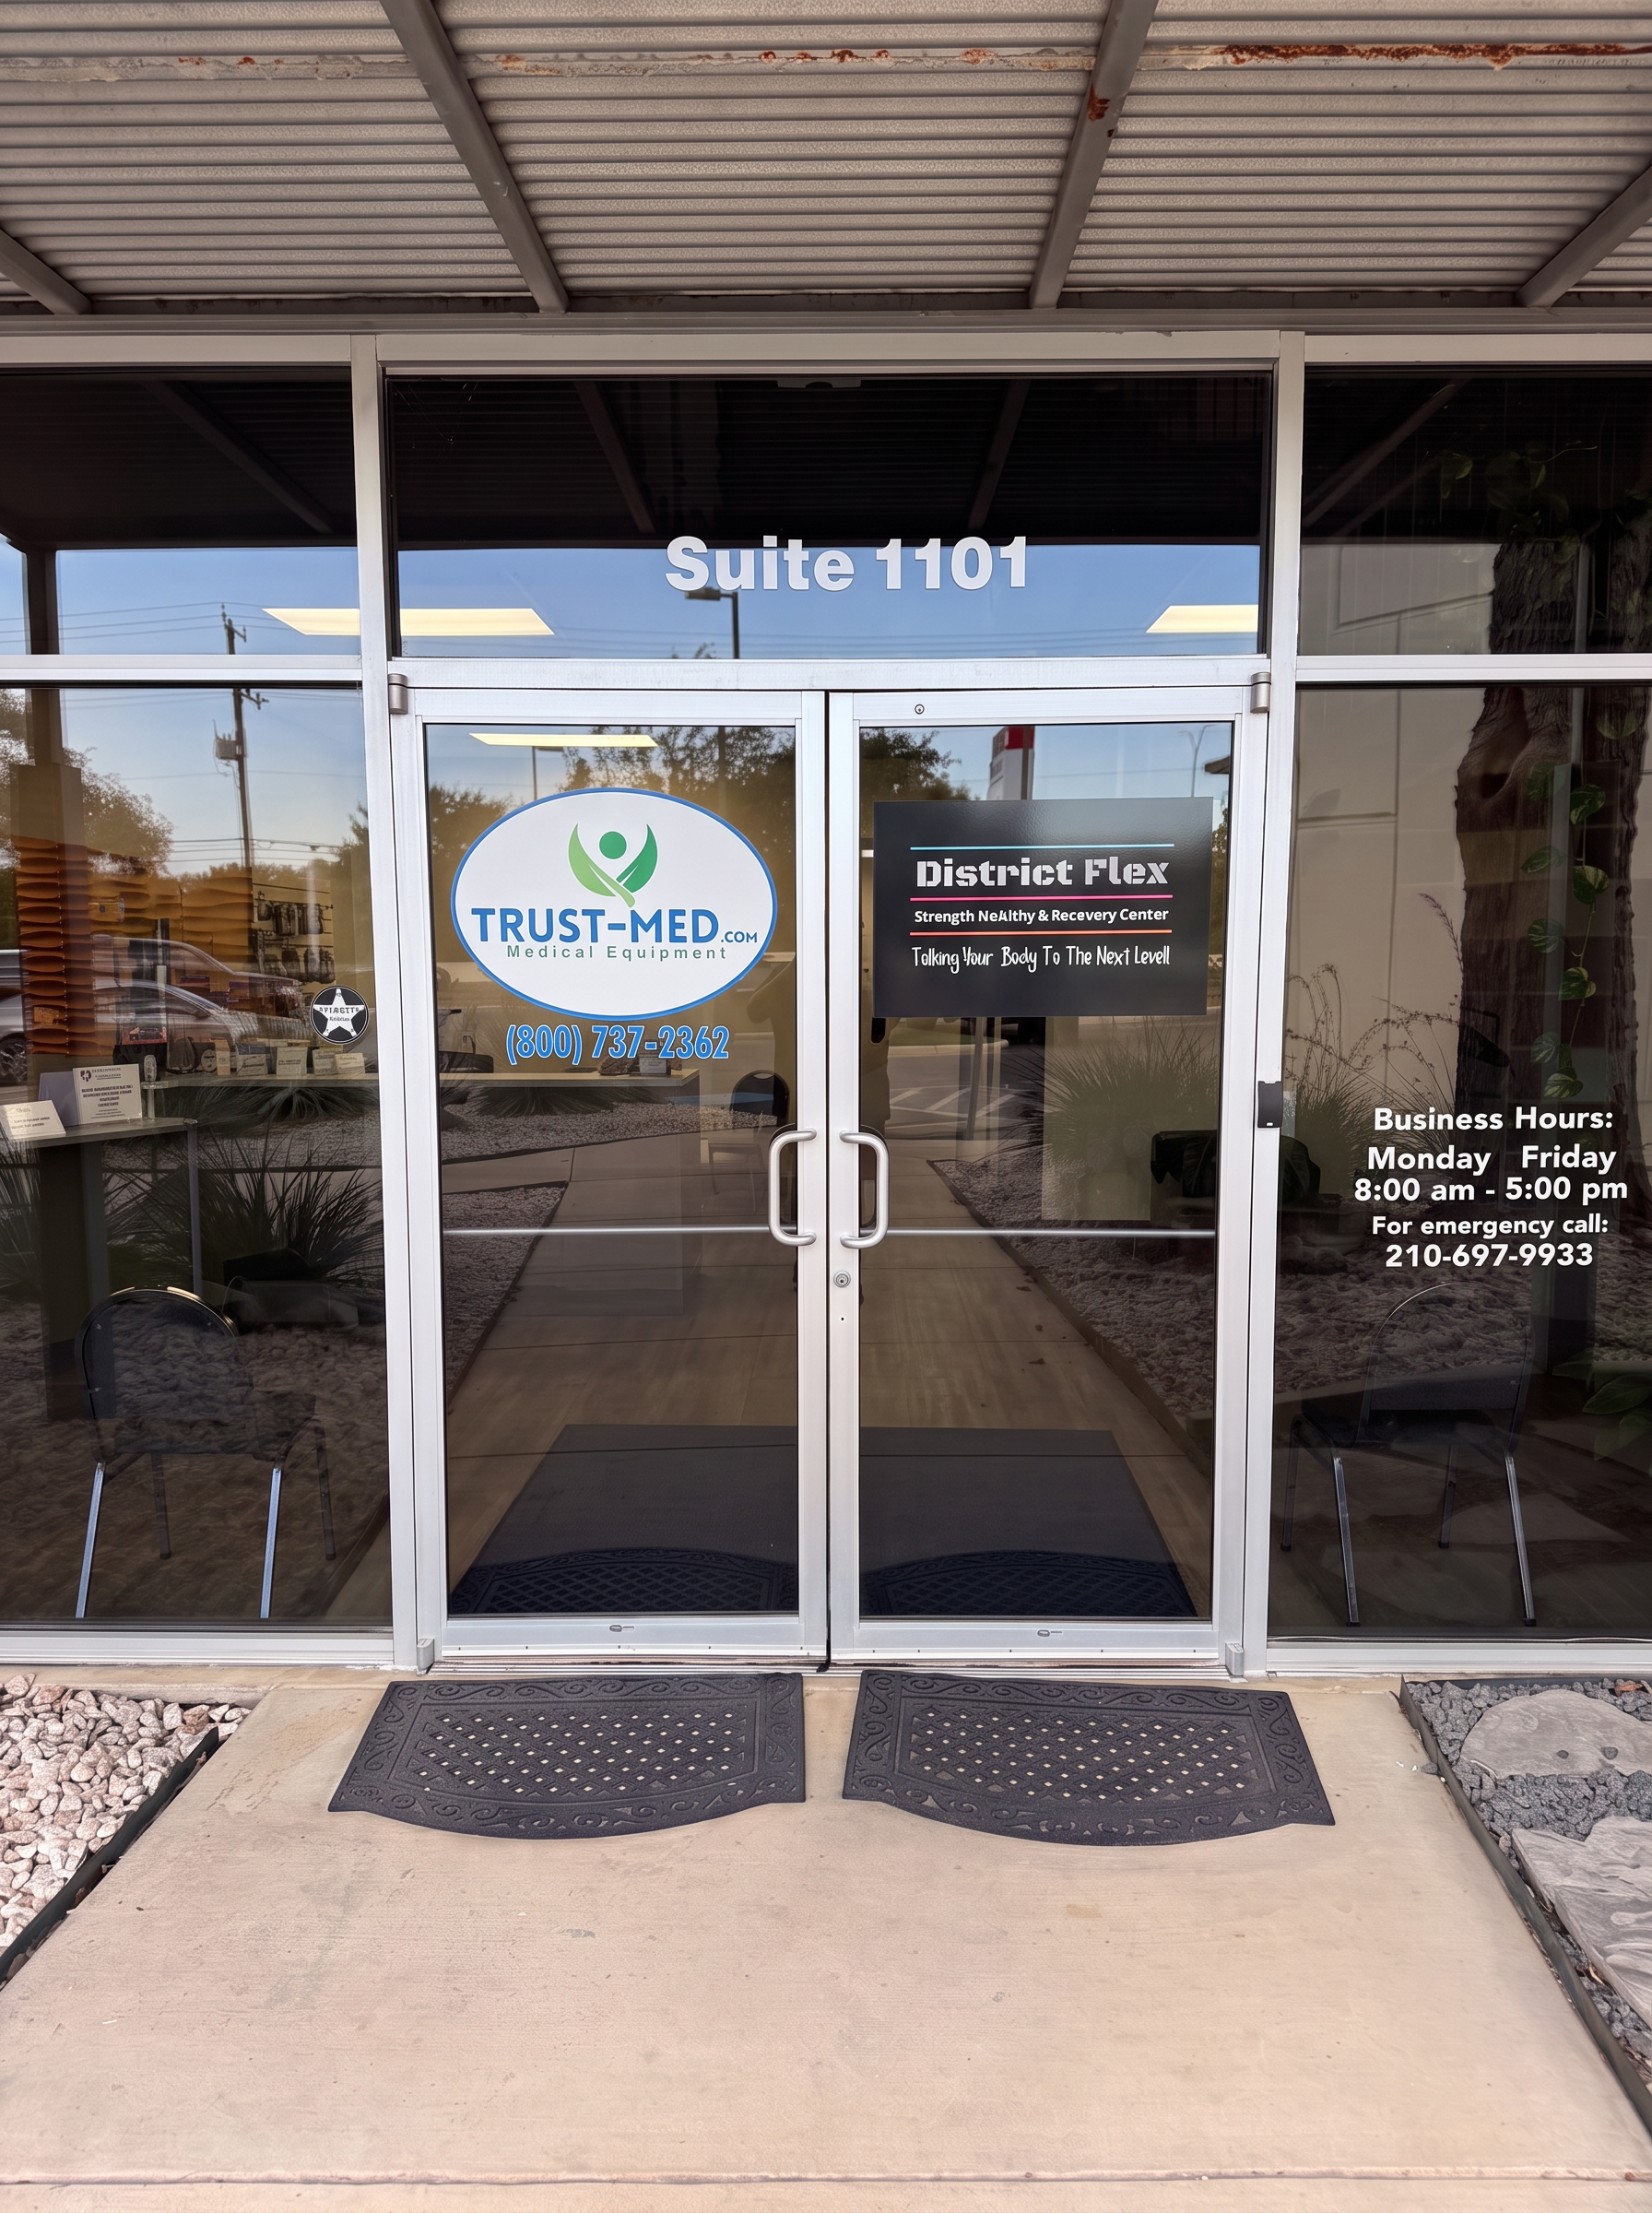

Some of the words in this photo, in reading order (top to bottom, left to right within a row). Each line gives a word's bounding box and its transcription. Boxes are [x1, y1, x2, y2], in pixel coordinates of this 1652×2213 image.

[665, 535, 855, 591] Suite
[876, 536, 1027, 590] 1101
[916, 858, 1073, 887] District
[1084, 856, 1170, 885] Flex
[914, 910, 974, 926] Strength
[1038, 909, 1049, 921] &
[1119, 908, 1169, 920] Center
[507, 945, 593, 958] Medical
[607, 945, 726, 962] Equipment
[1000, 946, 1038, 973] Body
[1043, 945, 1060, 965] To
[1066, 945, 1092, 965] The
[1096, 945, 1131, 965] Next
[506, 1024, 583, 1065] (800)
[591, 1024, 730, 1059] 737-2362
[1374, 1106, 1504, 1130] Business
[1515, 1106, 1614, 1130] Hours:
[1367, 1145, 1492, 1176] Monday
[1521, 1143, 1617, 1175] Friday
[1354, 1178, 1421, 1201] 8:00
[1431, 1183, 1475, 1201] am
[1504, 1177, 1572, 1200] 5:00
[1582, 1181, 1628, 1206] pm
[1372, 1215, 1413, 1235] For
[1421, 1218, 1555, 1239] emergency
[1562, 1213, 1609, 1234] call:
[1385, 1242, 1593, 1268] 210-697-9933
